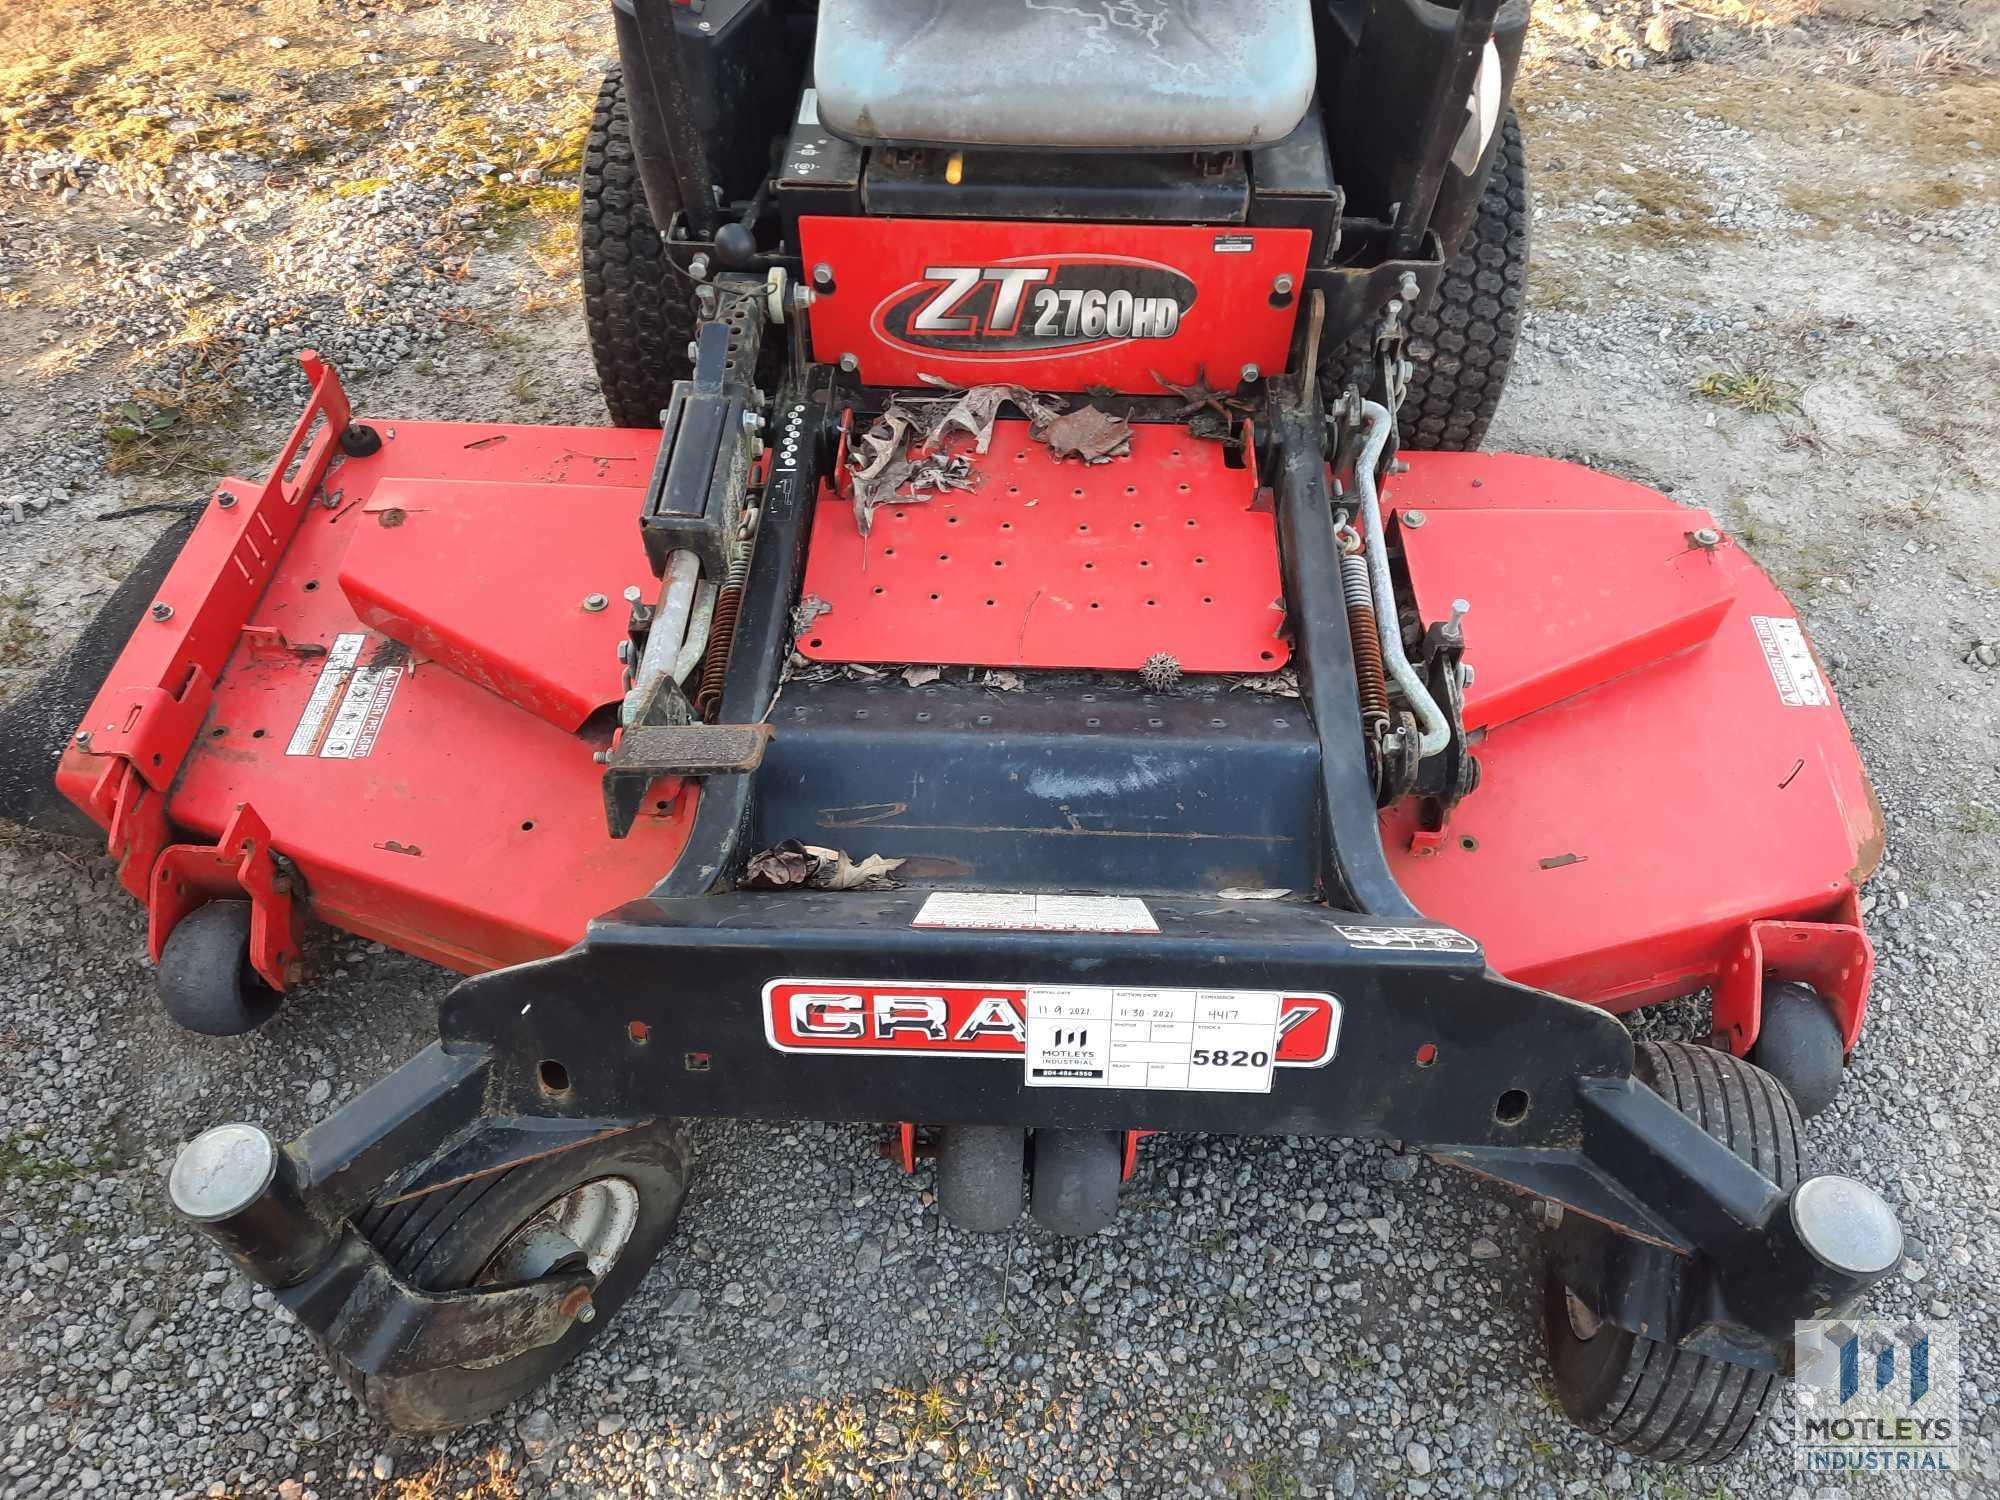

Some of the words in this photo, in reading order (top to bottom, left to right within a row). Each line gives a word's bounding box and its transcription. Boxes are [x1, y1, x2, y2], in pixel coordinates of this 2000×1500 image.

[913, 267, 1050, 331] ZT
[1033, 288, 1180, 339] 2760HD
[1042, 1050, 1094, 1058] MOTLEYS
[1192, 1049, 1269, 1068] 5820
